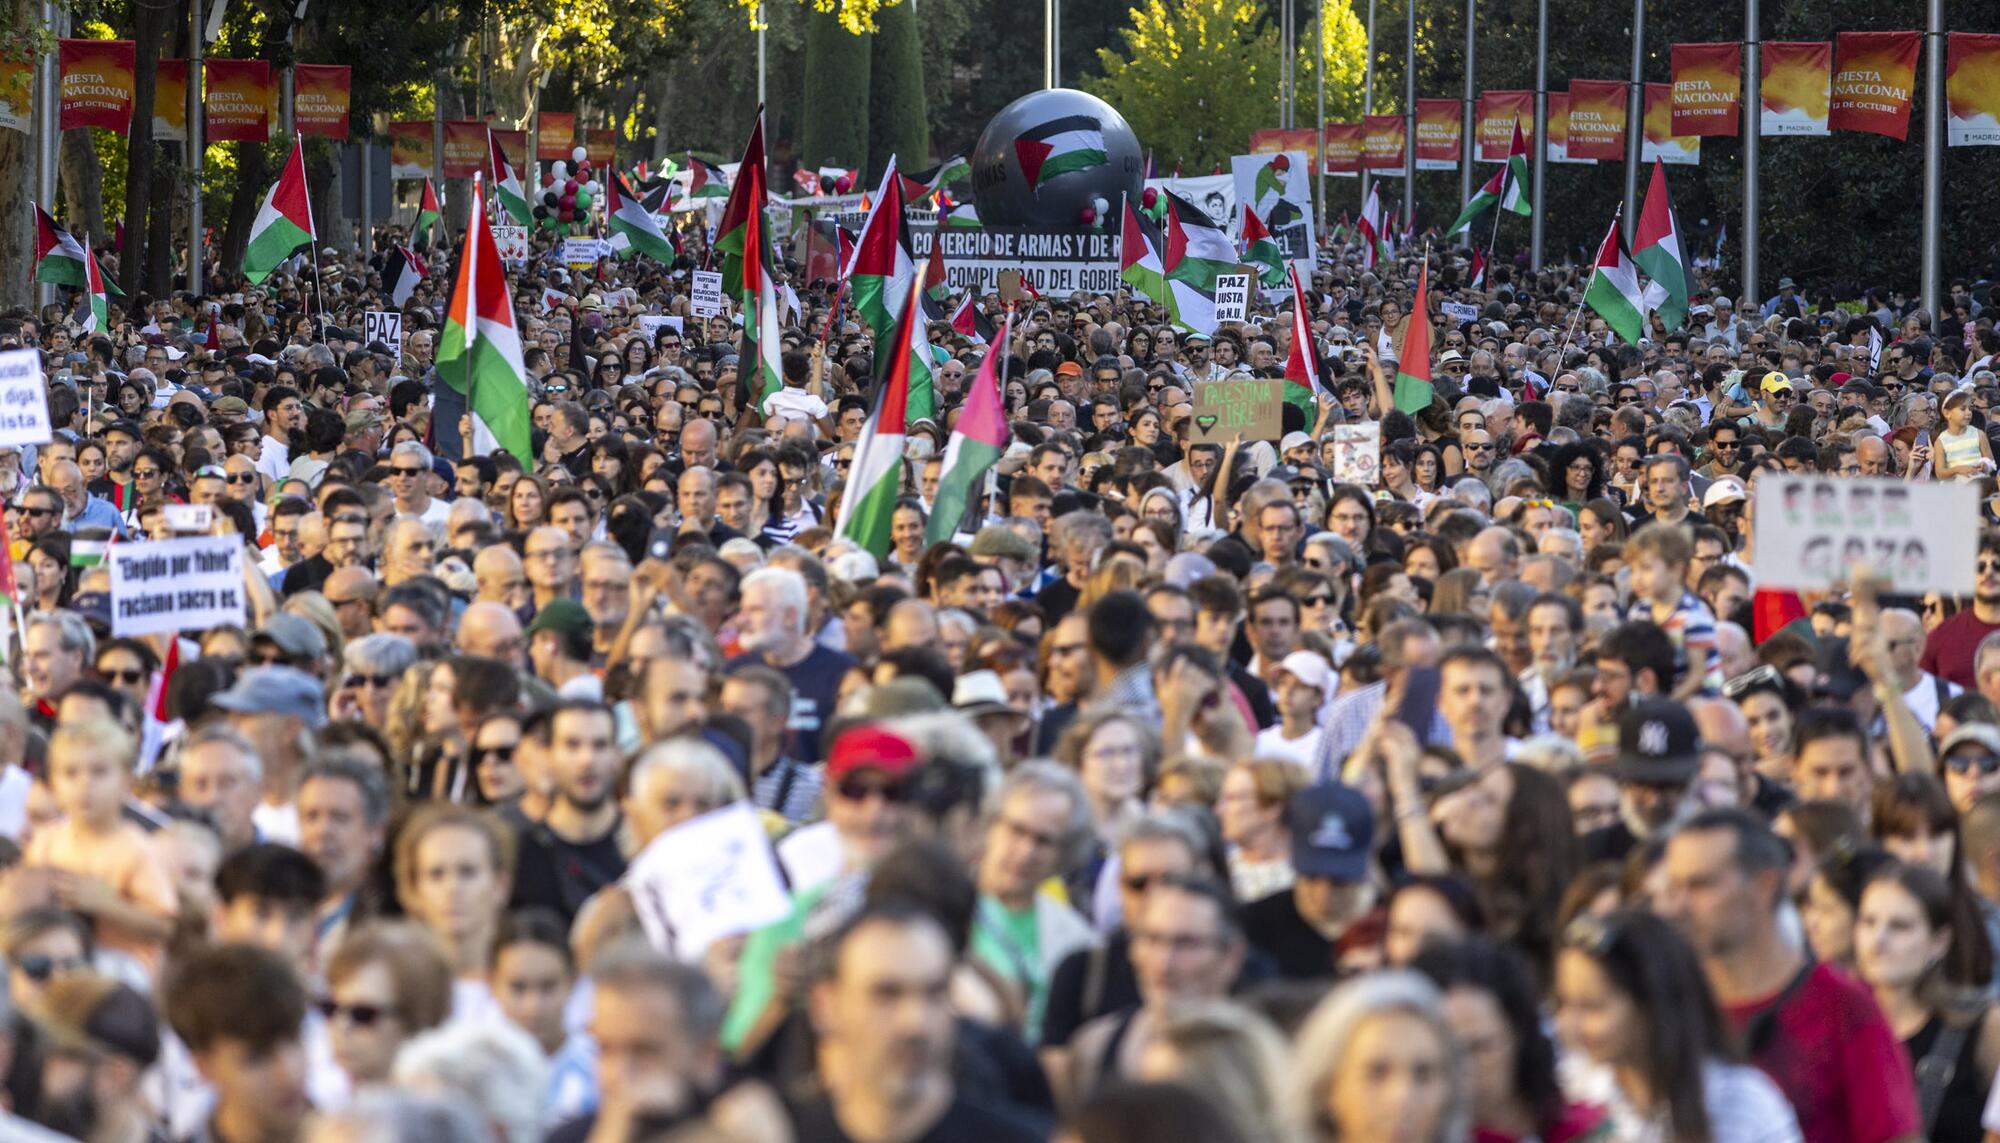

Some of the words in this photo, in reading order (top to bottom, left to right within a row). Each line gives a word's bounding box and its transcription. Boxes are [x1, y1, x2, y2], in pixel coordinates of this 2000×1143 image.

[64, 74, 104, 86] FIESTA
[1837, 70, 1881, 82] FIESTA
[1674, 80, 1711, 92] FIESTA
[64, 86, 129, 100] NACIONAL
[209, 92, 244, 101] FIESTA
[296, 94, 328, 103] FIESTA
[1674, 92, 1736, 104] NACIONAL
[1834, 84, 1909, 101] NACIONAL
[86, 101, 121, 112] OCTUBRE
[210, 104, 265, 114] NACIONAL
[297, 104, 346, 114] NACIONAL
[1692, 108, 1728, 116] OCTUBRE
[1856, 102, 1897, 114] OCTUBRE
[1570, 111, 1602, 120] FIESTA
[1484, 128, 1530, 136] NACIOAL
[1570, 122, 1622, 133] NACIONAL
[492, 227, 516, 240] STOP
[995, 234, 1014, 256] DE
[1018, 234, 1072, 257] ARMAS
[1076, 234, 1086, 257] Y
[1090, 234, 1108, 257] DE
[948, 266, 1045, 290] COMPLAD
[1050, 269, 1076, 290] DEL
[1080, 269, 1121, 290] GOBIE
[1218, 276, 1245, 288] PAZ
[1217, 292, 1243, 304] JUSTA
[1216, 309, 1225, 320] de
[1226, 308, 1242, 319] N.U.
[1453, 305, 1476, 316] CRIMEN
[366, 313, 399, 344] PAZ
[1204, 382, 1272, 406] PALESTINA
[1782, 481, 1911, 526] FREE
[1799, 535, 1930, 581] GAZA
[171, 555, 190, 578] por
[118, 592, 173, 618] racismo
[178, 590, 216, 608] sacro
